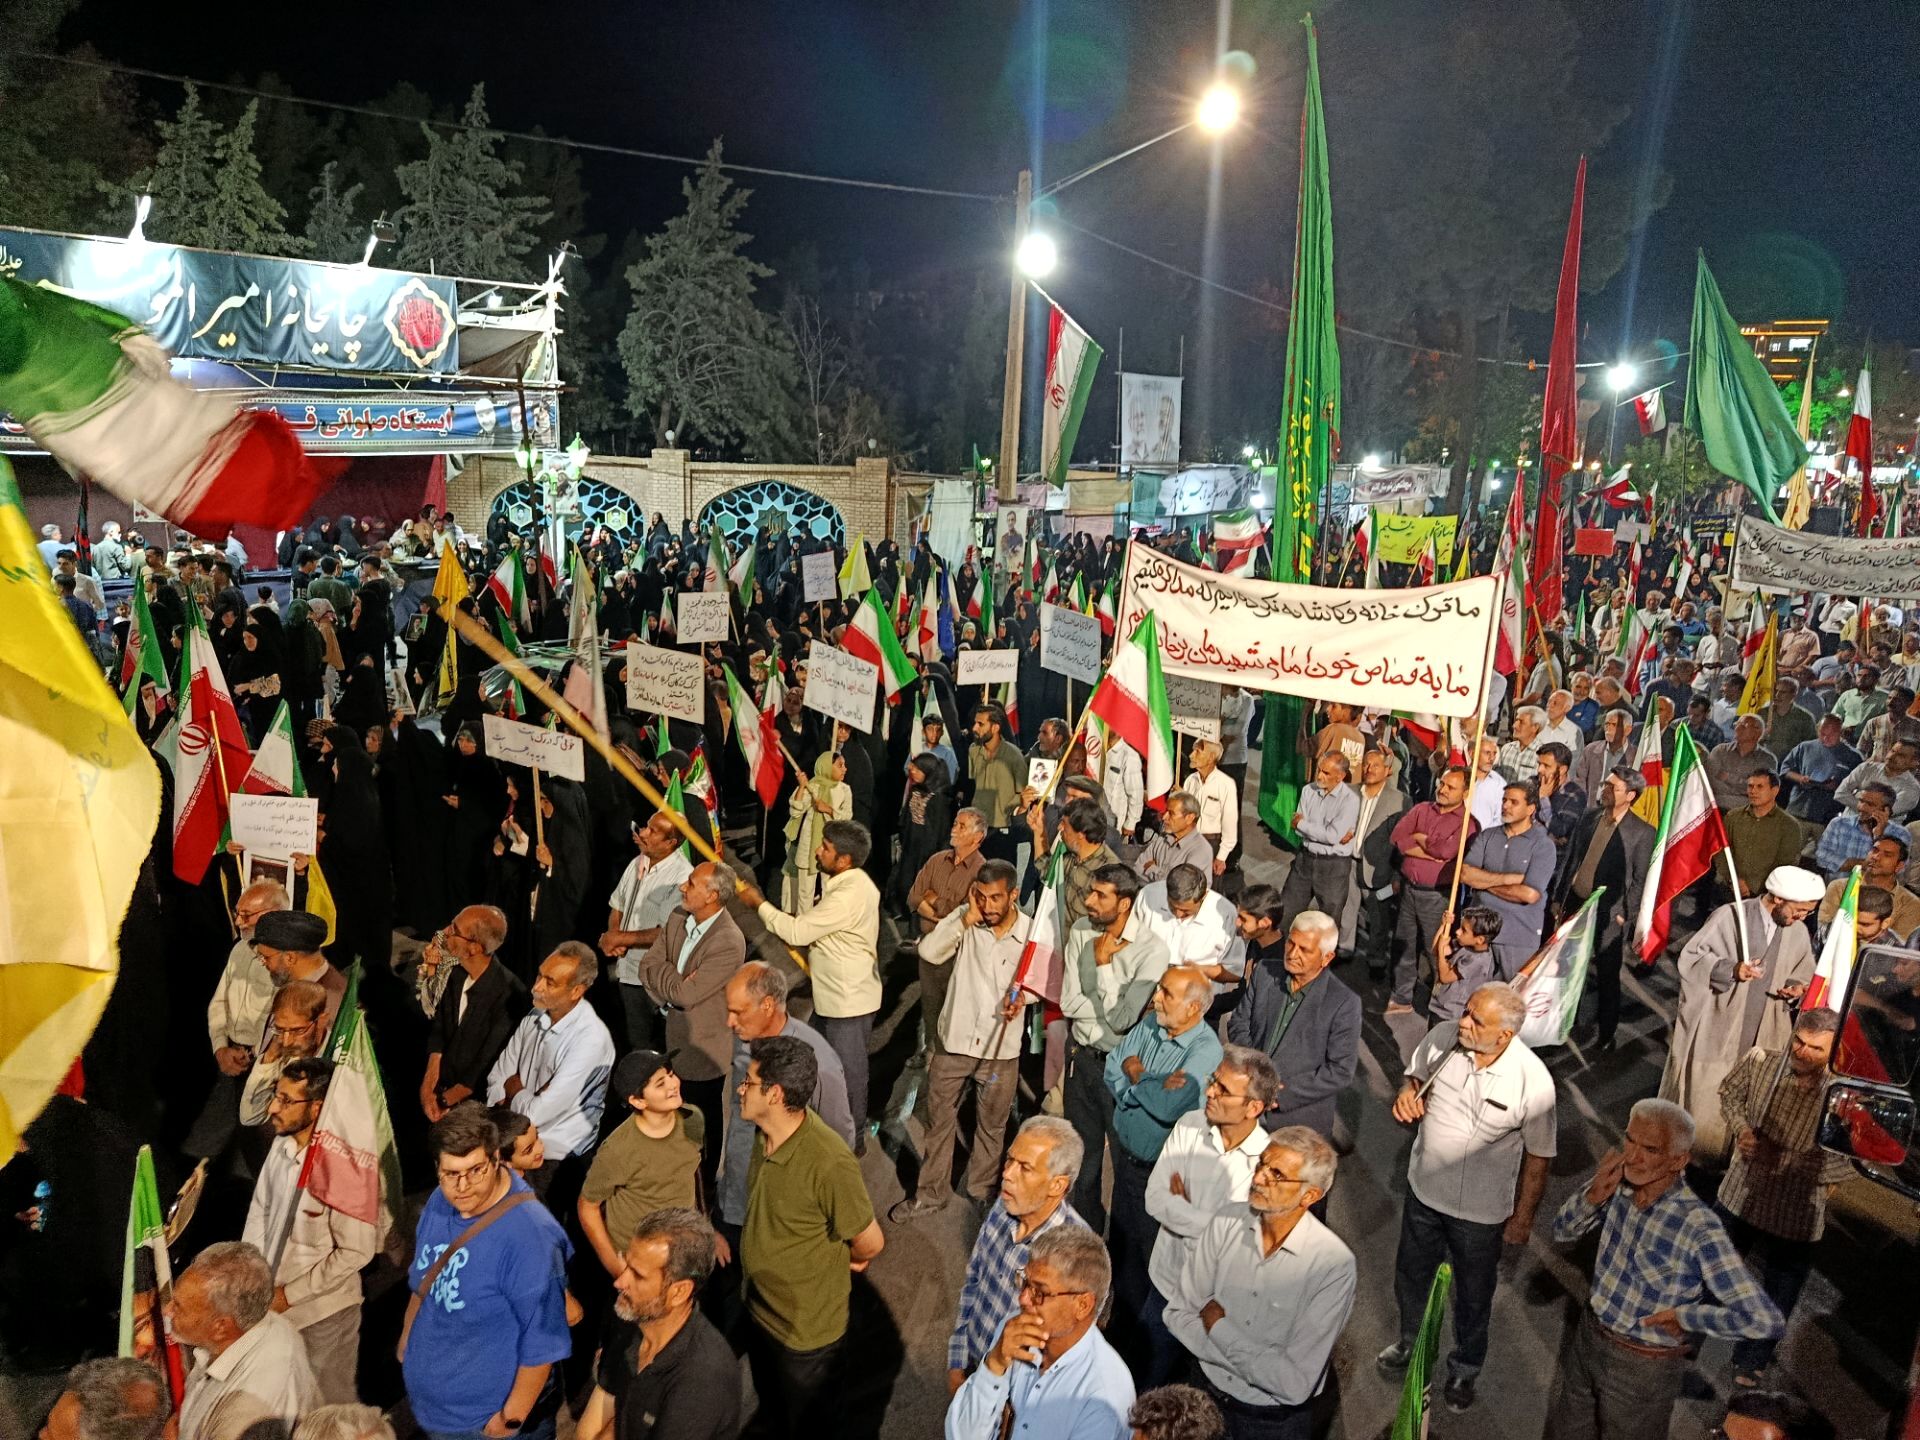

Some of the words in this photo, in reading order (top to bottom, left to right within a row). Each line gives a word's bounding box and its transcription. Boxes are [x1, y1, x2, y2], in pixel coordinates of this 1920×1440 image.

[192, 282, 272, 347] امیر
[281, 284, 367, 362] چایخانه
[320, 407, 388, 438] صلواتی
[389, 405, 453, 435] ایستگاه
[1133, 558, 1162, 596] کنیم
[1196, 580, 1216, 602] که
[1359, 602, 1400, 622] خانه
[1403, 591, 1453, 622] ترک
[1456, 597, 1480, 618] ما
[1187, 628, 1265, 672] شهیدمان
[1266, 645, 1313, 680] امام
[1305, 652, 1359, 678] خون
[1351, 656, 1425, 686] قصاص
[1419, 665, 1442, 699] به
[1447, 664, 1470, 697] ما
